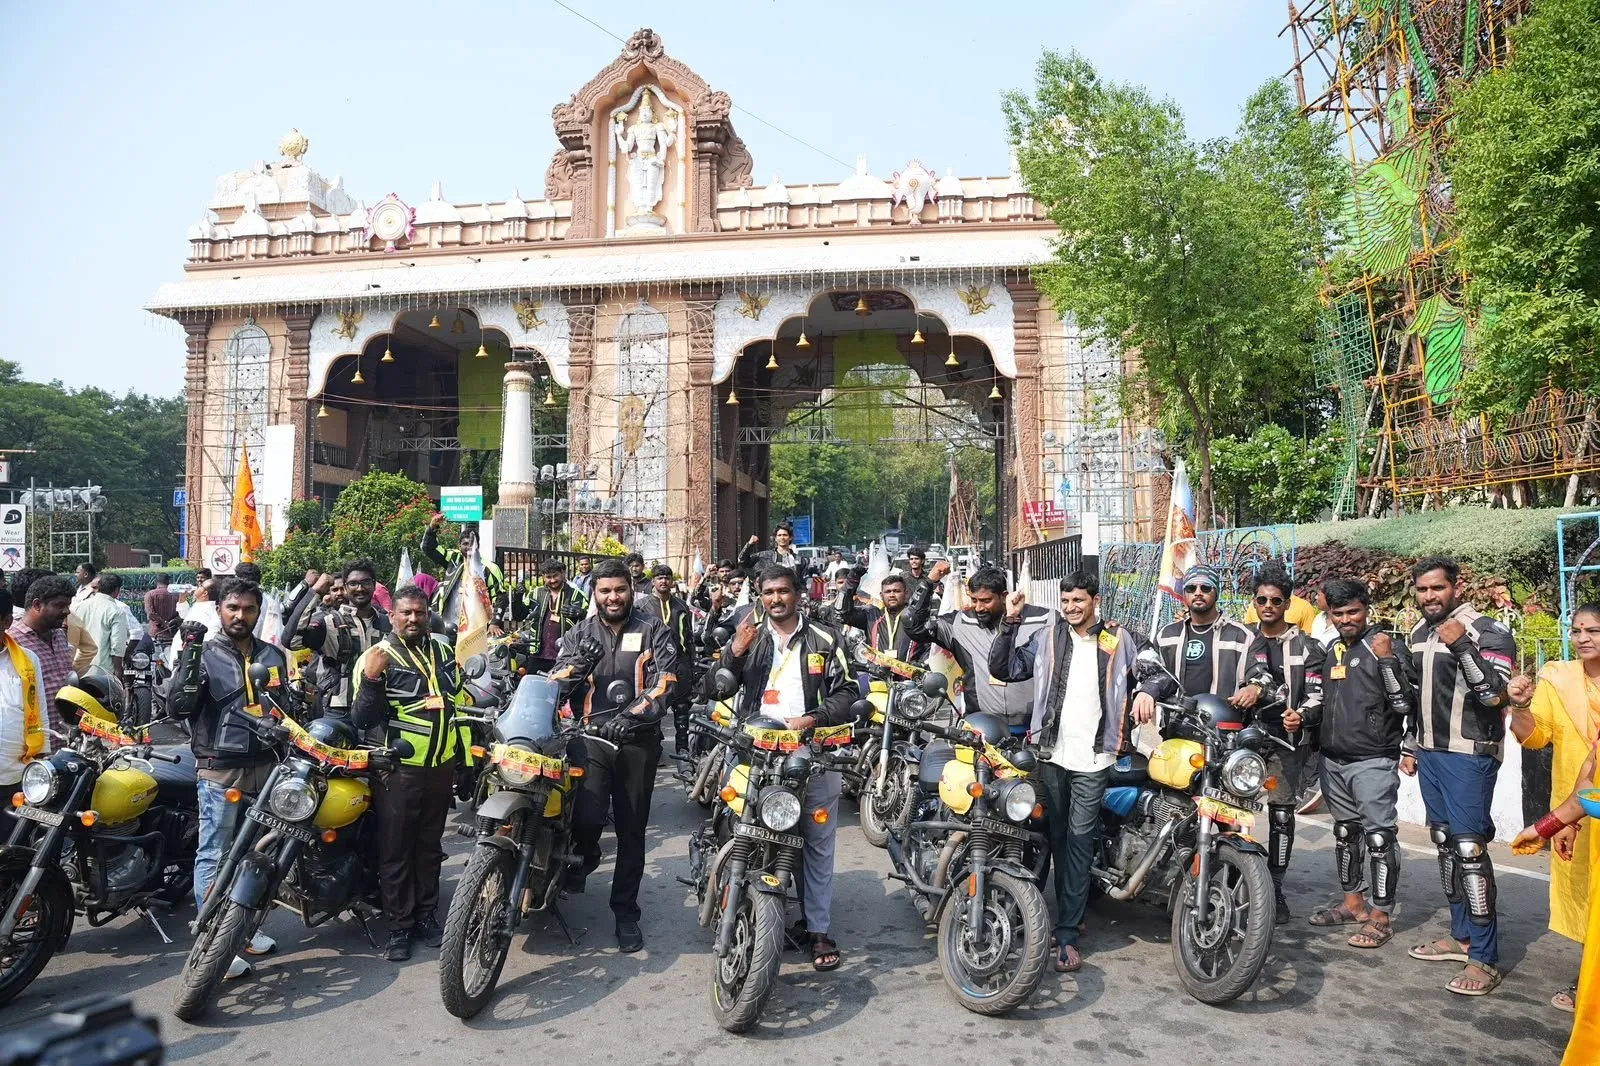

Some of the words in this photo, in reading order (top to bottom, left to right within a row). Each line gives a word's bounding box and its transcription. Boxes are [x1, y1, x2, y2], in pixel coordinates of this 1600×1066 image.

[253, 811, 265, 822] KA
[290, 827, 310, 841] 1956
[746, 827, 756, 836] KA
